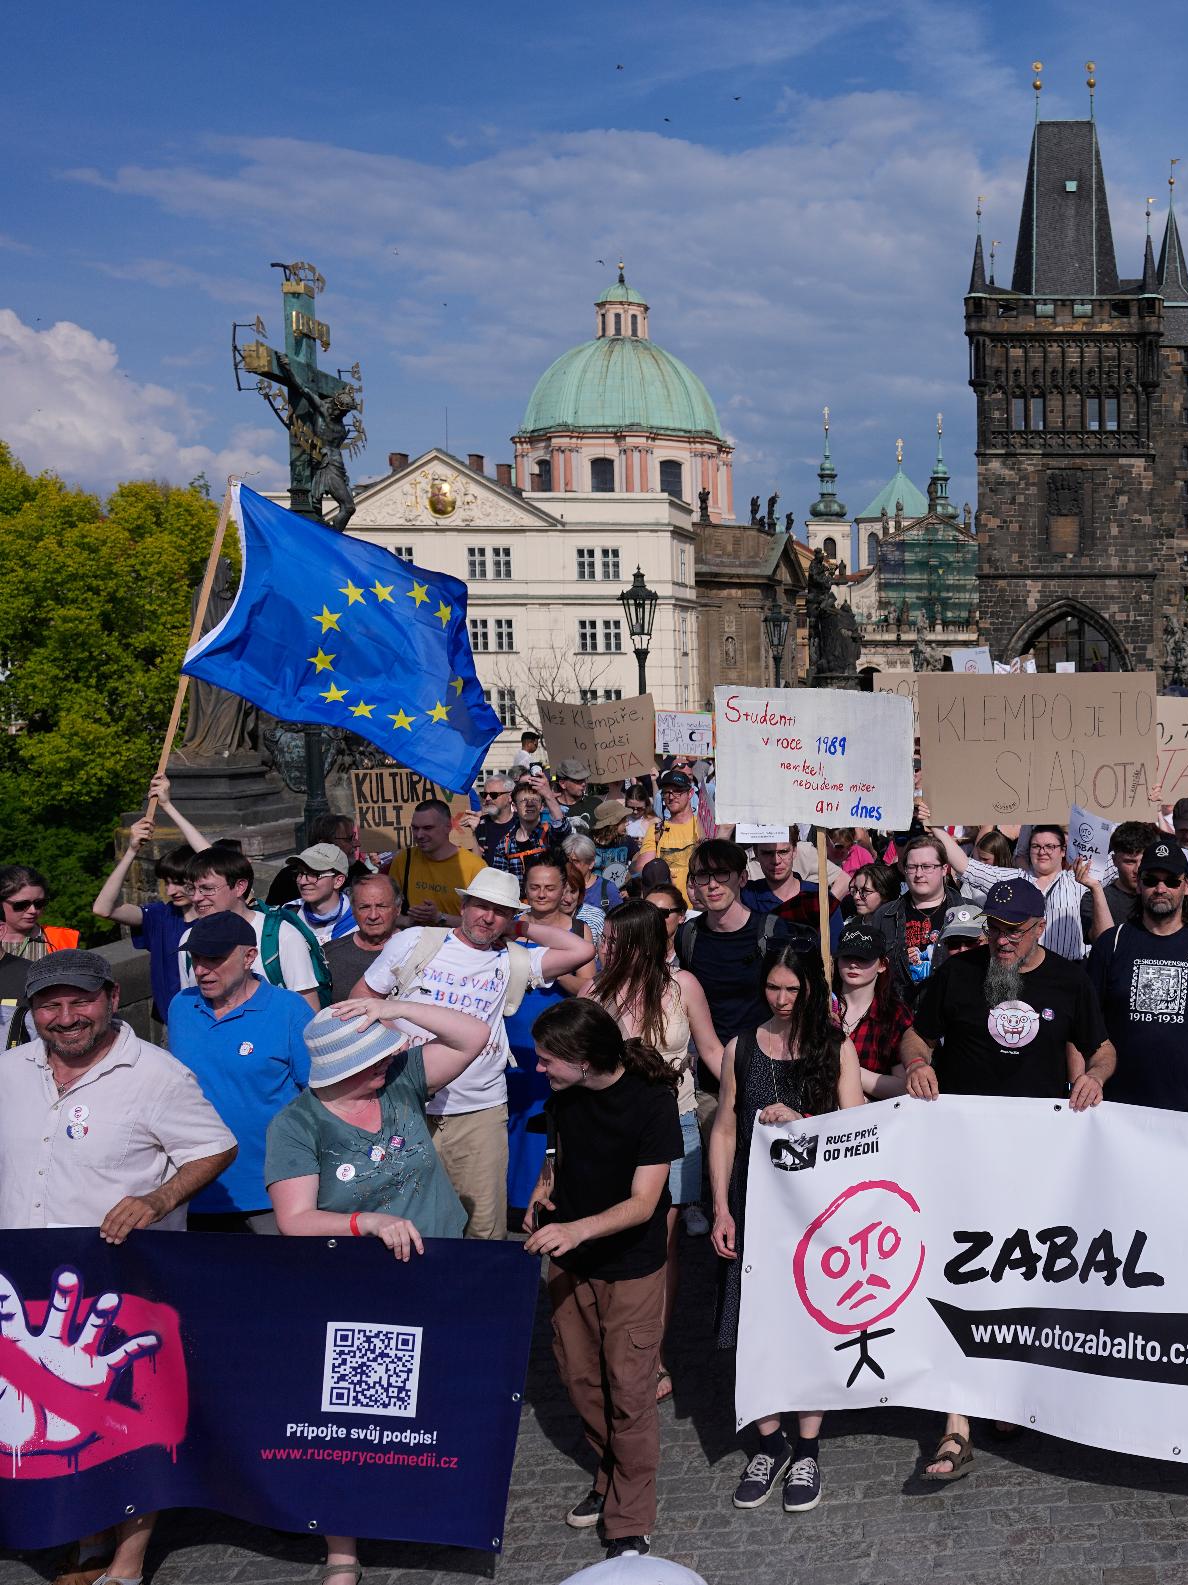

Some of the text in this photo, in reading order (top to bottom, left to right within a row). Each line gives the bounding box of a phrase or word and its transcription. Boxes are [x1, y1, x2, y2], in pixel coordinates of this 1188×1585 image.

[724, 695, 797, 728] Studenti
[937, 692, 1076, 744] KLEMPO,
[1084, 706, 1107, 739] JE
[1111, 690, 1153, 738] TO
[593, 733, 630, 751] radši
[761, 736, 847, 756] v roce 1989
[994, 749, 1152, 815] SLABOTA
[358, 805, 404, 829] KULT
[815, 797, 883, 822] ani dnes
[1072, 838, 1101, 855] ZABAL
[1129, 1012, 1185, 1024] 1918-1938
[825, 1124, 879, 1146] RUCE PRYČ
[823, 1137, 880, 1163] OD MÉDIÍ
[820, 1220, 902, 1280] OTO
[943, 1225, 1166, 1290] ZABAL
[286, 1422, 438, 1447] Připojte svůj podpis!
[259, 1447, 459, 1469] www.ruceprycodmedii.cz
